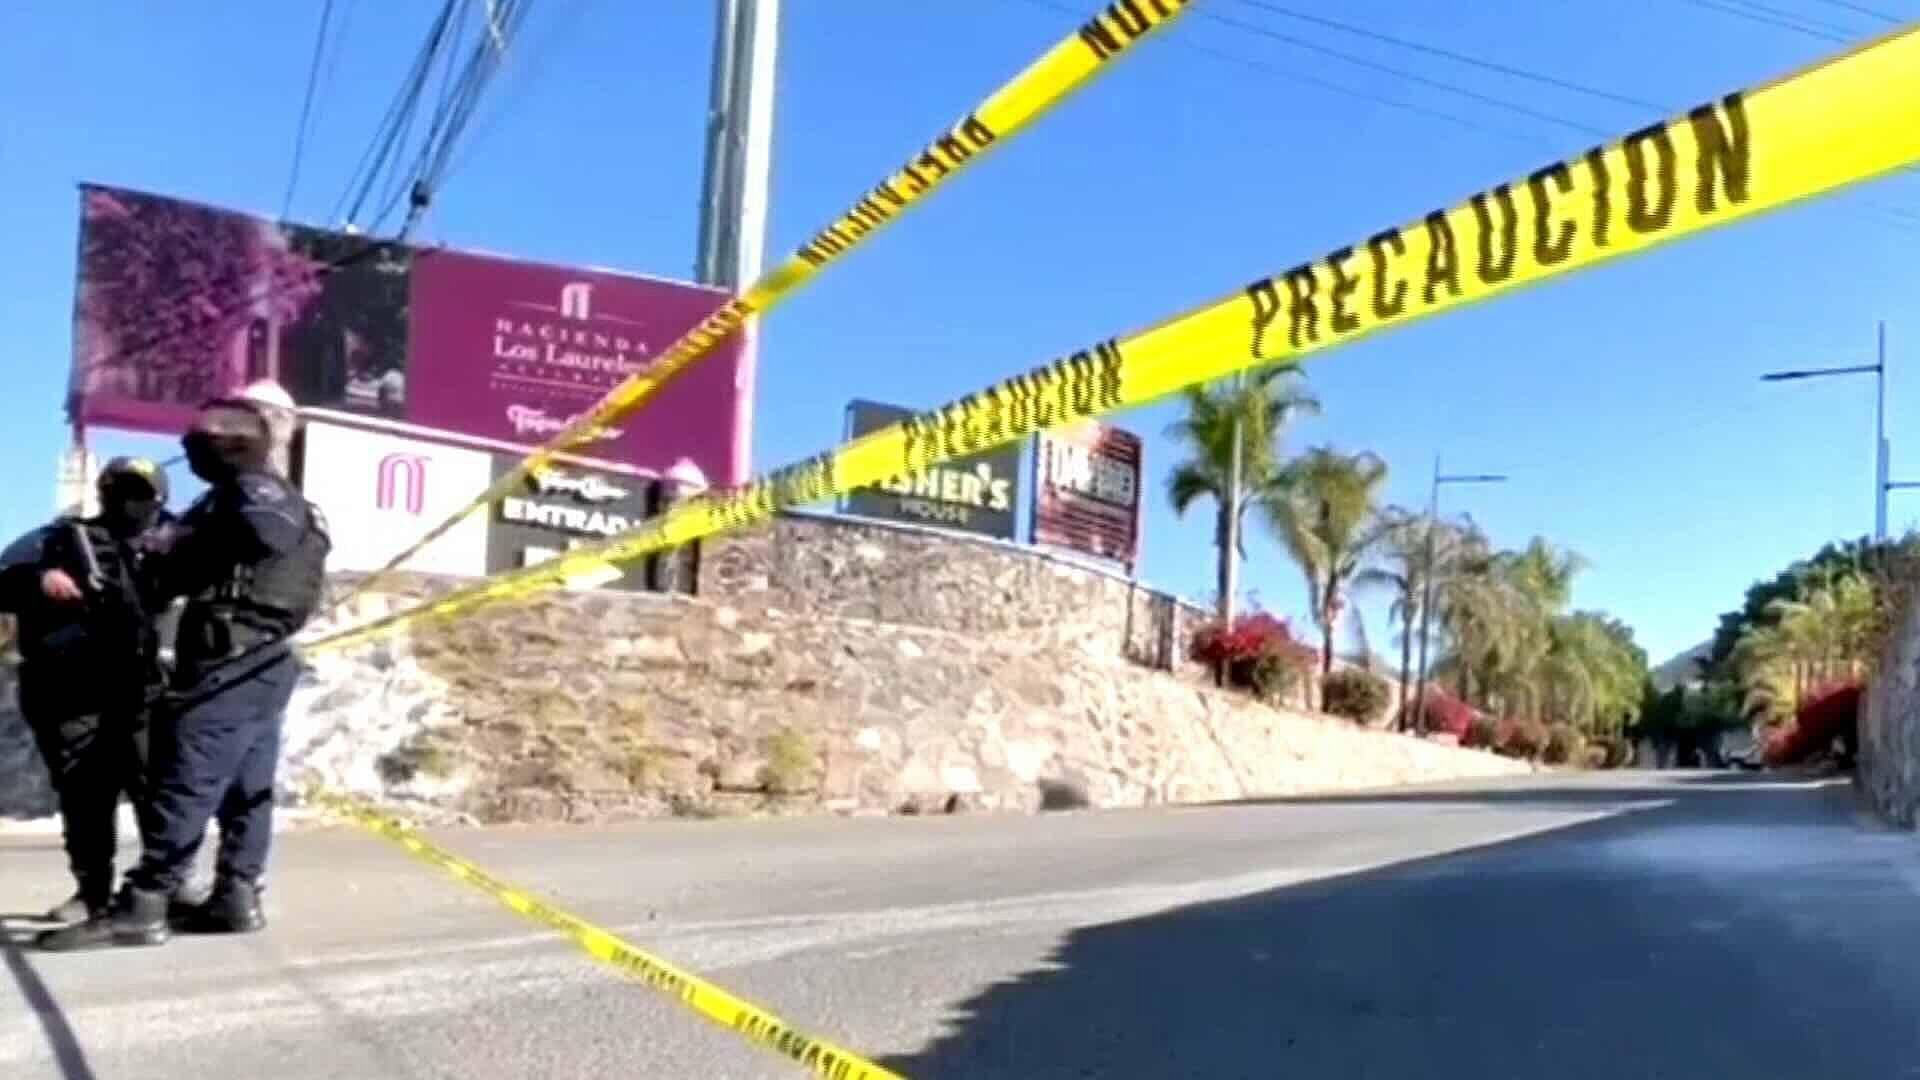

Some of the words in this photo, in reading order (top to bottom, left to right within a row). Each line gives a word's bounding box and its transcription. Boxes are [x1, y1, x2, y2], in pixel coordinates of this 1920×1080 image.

[1246, 91, 1751, 359] PRECAUCION
[493, 335, 538, 357] Los
[495, 318, 650, 354] HACIENDA
[903, 340, 1122, 470] PRECAUCION
[503, 496, 643, 536] ENTRAD
